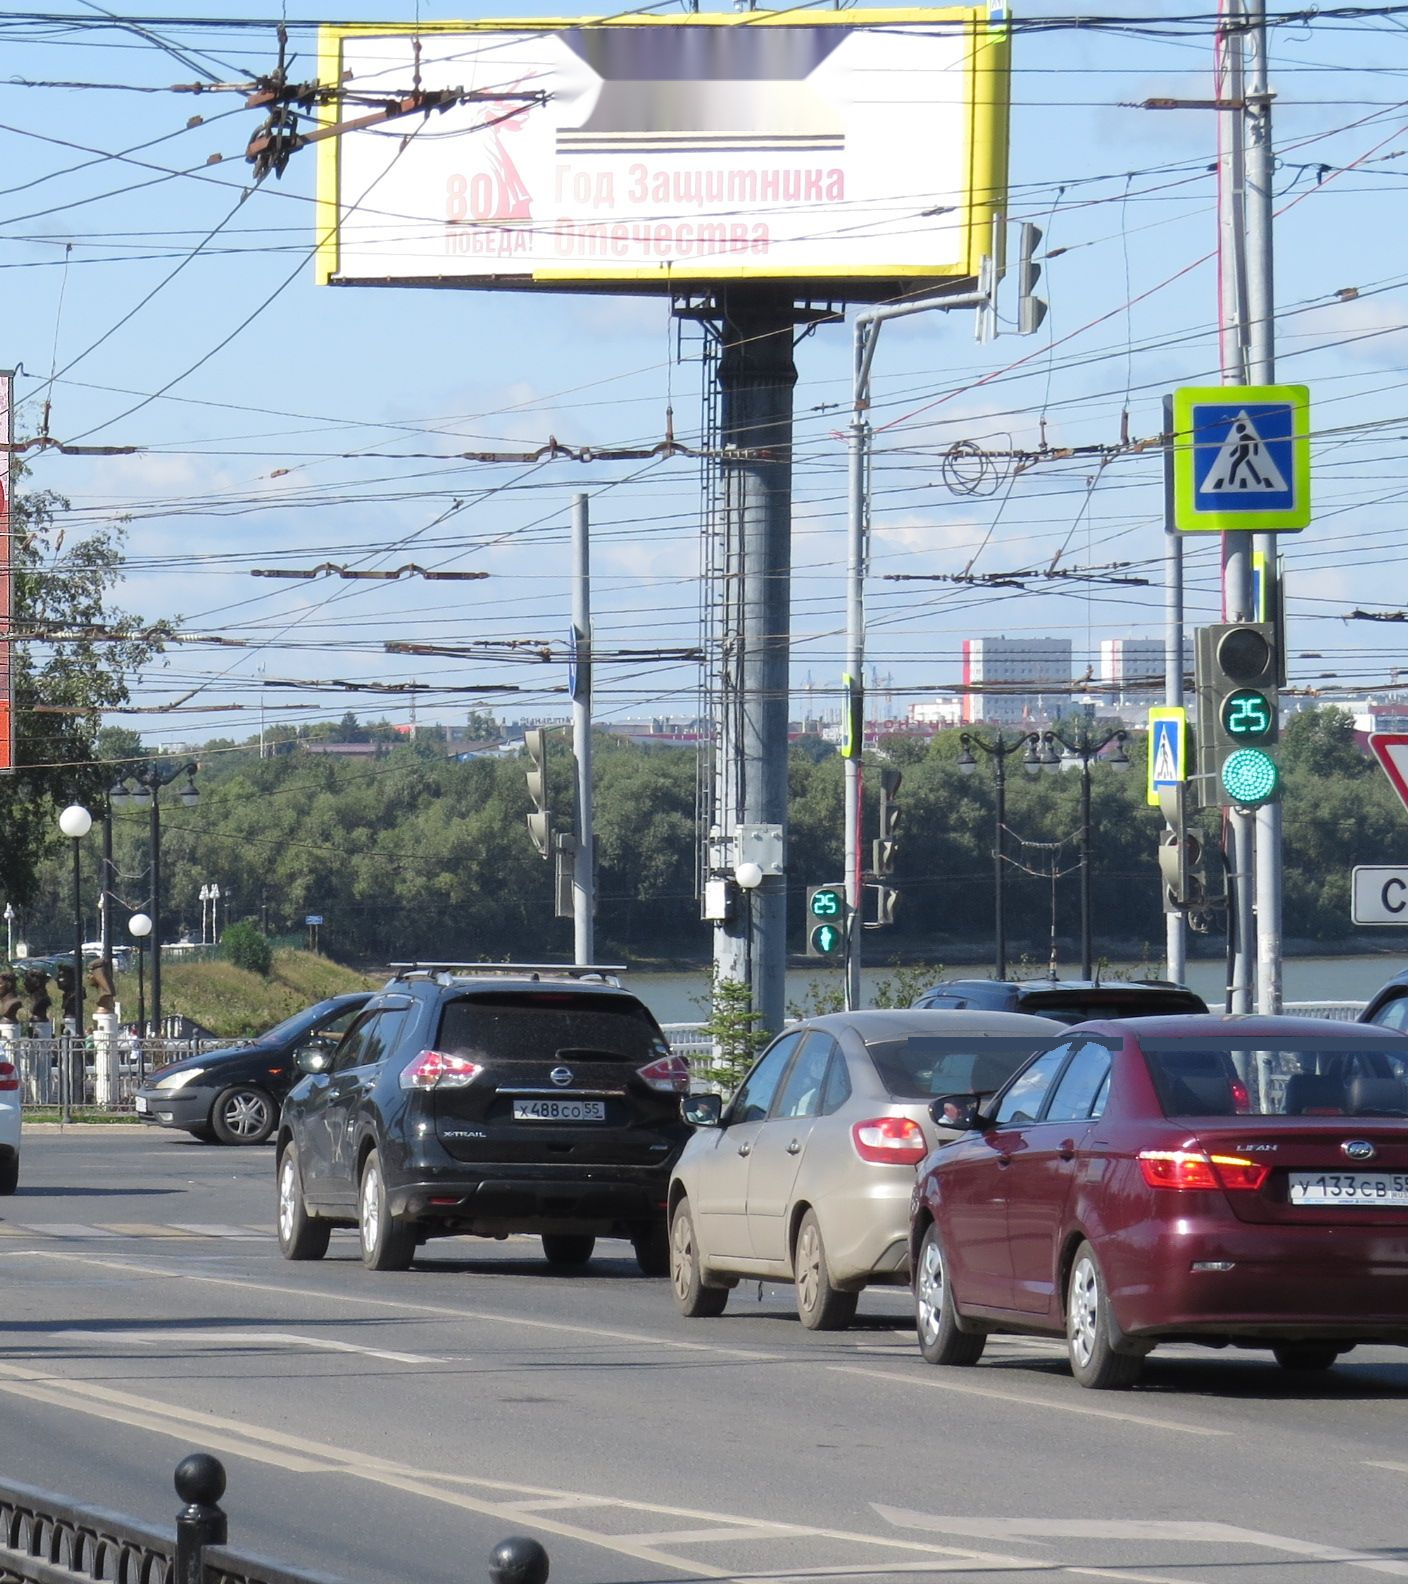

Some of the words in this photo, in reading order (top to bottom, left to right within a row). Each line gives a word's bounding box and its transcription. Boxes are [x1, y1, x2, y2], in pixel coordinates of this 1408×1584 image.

[446, 172, 492, 220] 80
[555, 164, 615, 208] Год
[628, 163, 845, 207] Защитника
[445, 230, 534, 257] ПОБЕДА!
[554, 216, 770, 257] Отечества
[1230, 699, 1265, 731] 25
[814, 894, 836, 914] 25
[520, 1103, 580, 1117] Х488СО
[585, 1103, 599, 1114] 55
[1298, 1176, 1387, 1198] У133СВ
